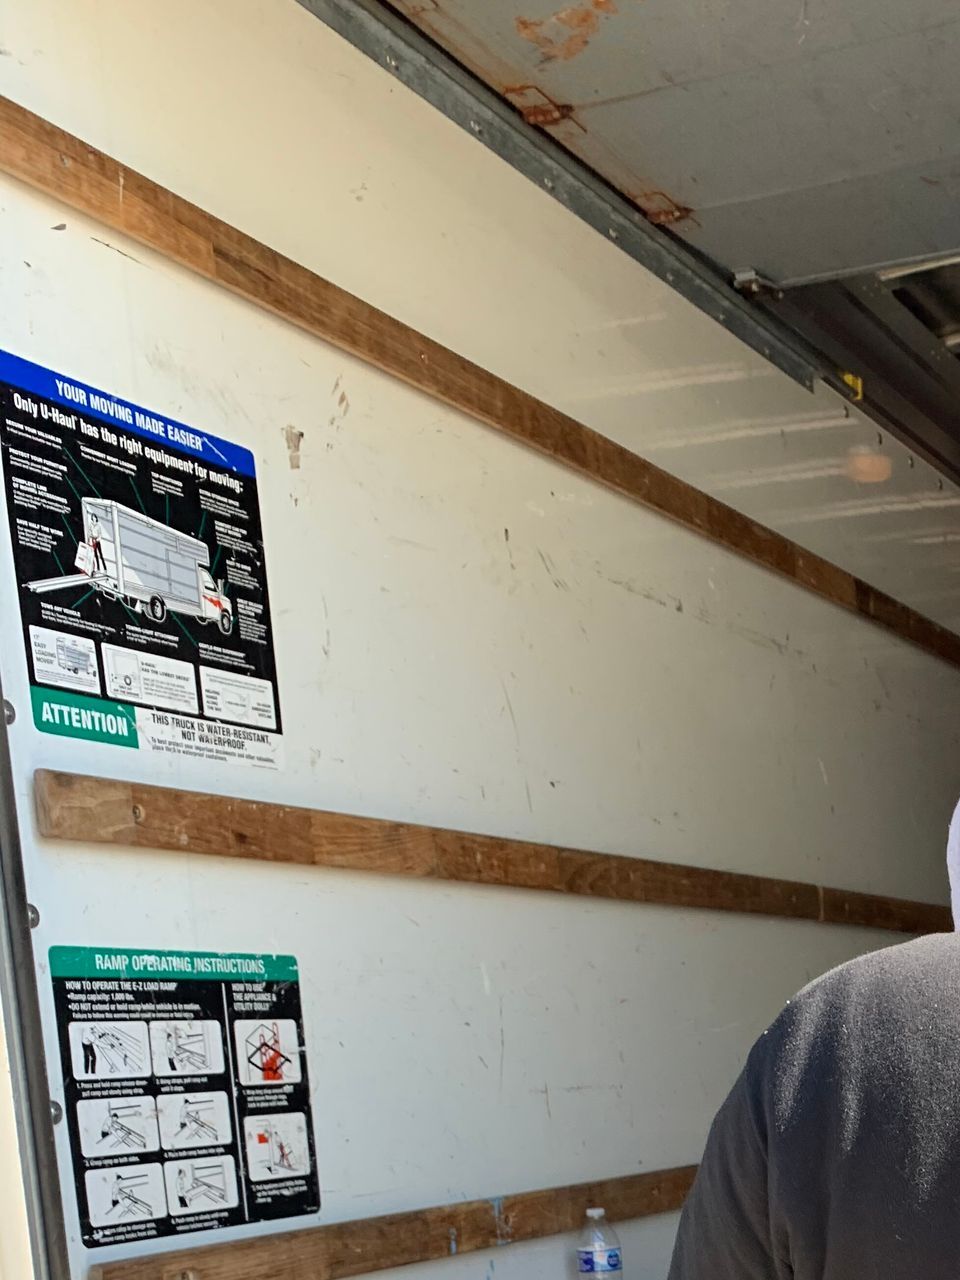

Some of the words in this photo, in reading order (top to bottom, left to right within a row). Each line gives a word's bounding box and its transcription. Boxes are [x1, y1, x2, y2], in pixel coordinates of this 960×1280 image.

[55, 379, 87, 406] YOUR
[89, 393, 133, 424] MOVING
[135, 412, 166, 437] MADE
[13, 392, 38, 418] Only
[80, 418, 99, 439] has
[100, 427, 117, 446] the
[119, 434, 143, 456] right
[144, 446, 194, 474] equipment
[195, 462, 207, 479] for
[42, 701, 128, 737] ATTENTION
[151, 713, 169, 726] THIS
[171, 717, 196, 731] TRUCK
[197, 722, 205, 733] IS
[181, 730, 196, 742] NOT
[95, 954, 129, 971] RAMP
[132, 955, 192, 972] OPERATING
[194, 958, 265, 973] INSTRUCTIONS
[65, 981, 81, 991] HOW
[82, 981, 91, 991] TO
[92, 981, 119, 991] OPERATE
[120, 981, 132, 991] THE
[144, 982, 159, 991] LOAD
